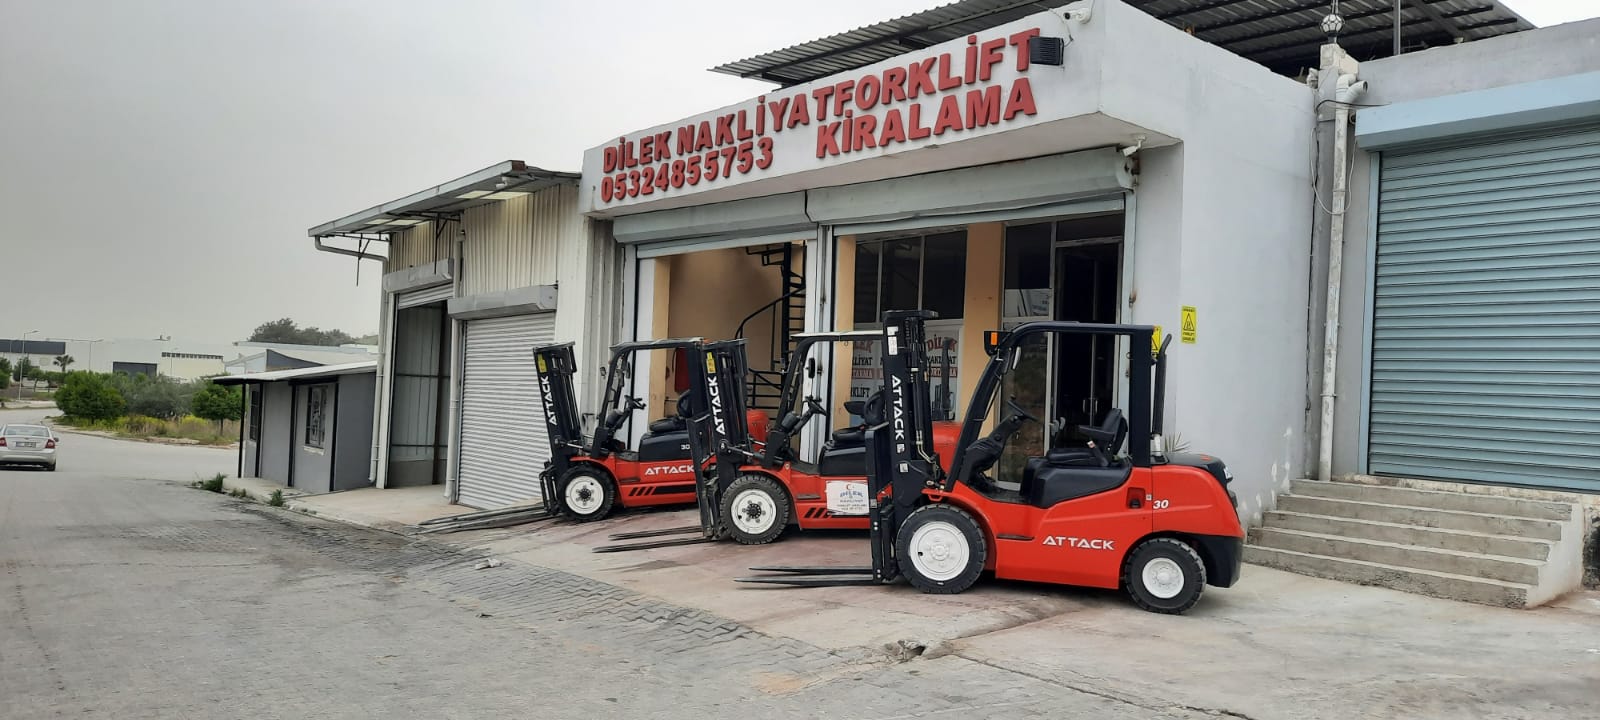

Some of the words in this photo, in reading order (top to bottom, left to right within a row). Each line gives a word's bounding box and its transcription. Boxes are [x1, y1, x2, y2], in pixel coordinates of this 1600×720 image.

[603, 131, 672, 173] DİLEK
[834, 28, 1040, 117] FORKLİFT
[816, 78, 1037, 159] KİRALAMA
[600, 137, 774, 203] 05324855753
[541, 375, 558, 426] ATTACK
[707, 376, 727, 435] ATTACK
[891, 374, 905, 441] ATTACK
[644, 465, 696, 476] ATTACK
[1152, 499, 1170, 510] 30
[1041, 534, 1115, 551] ATTACK
